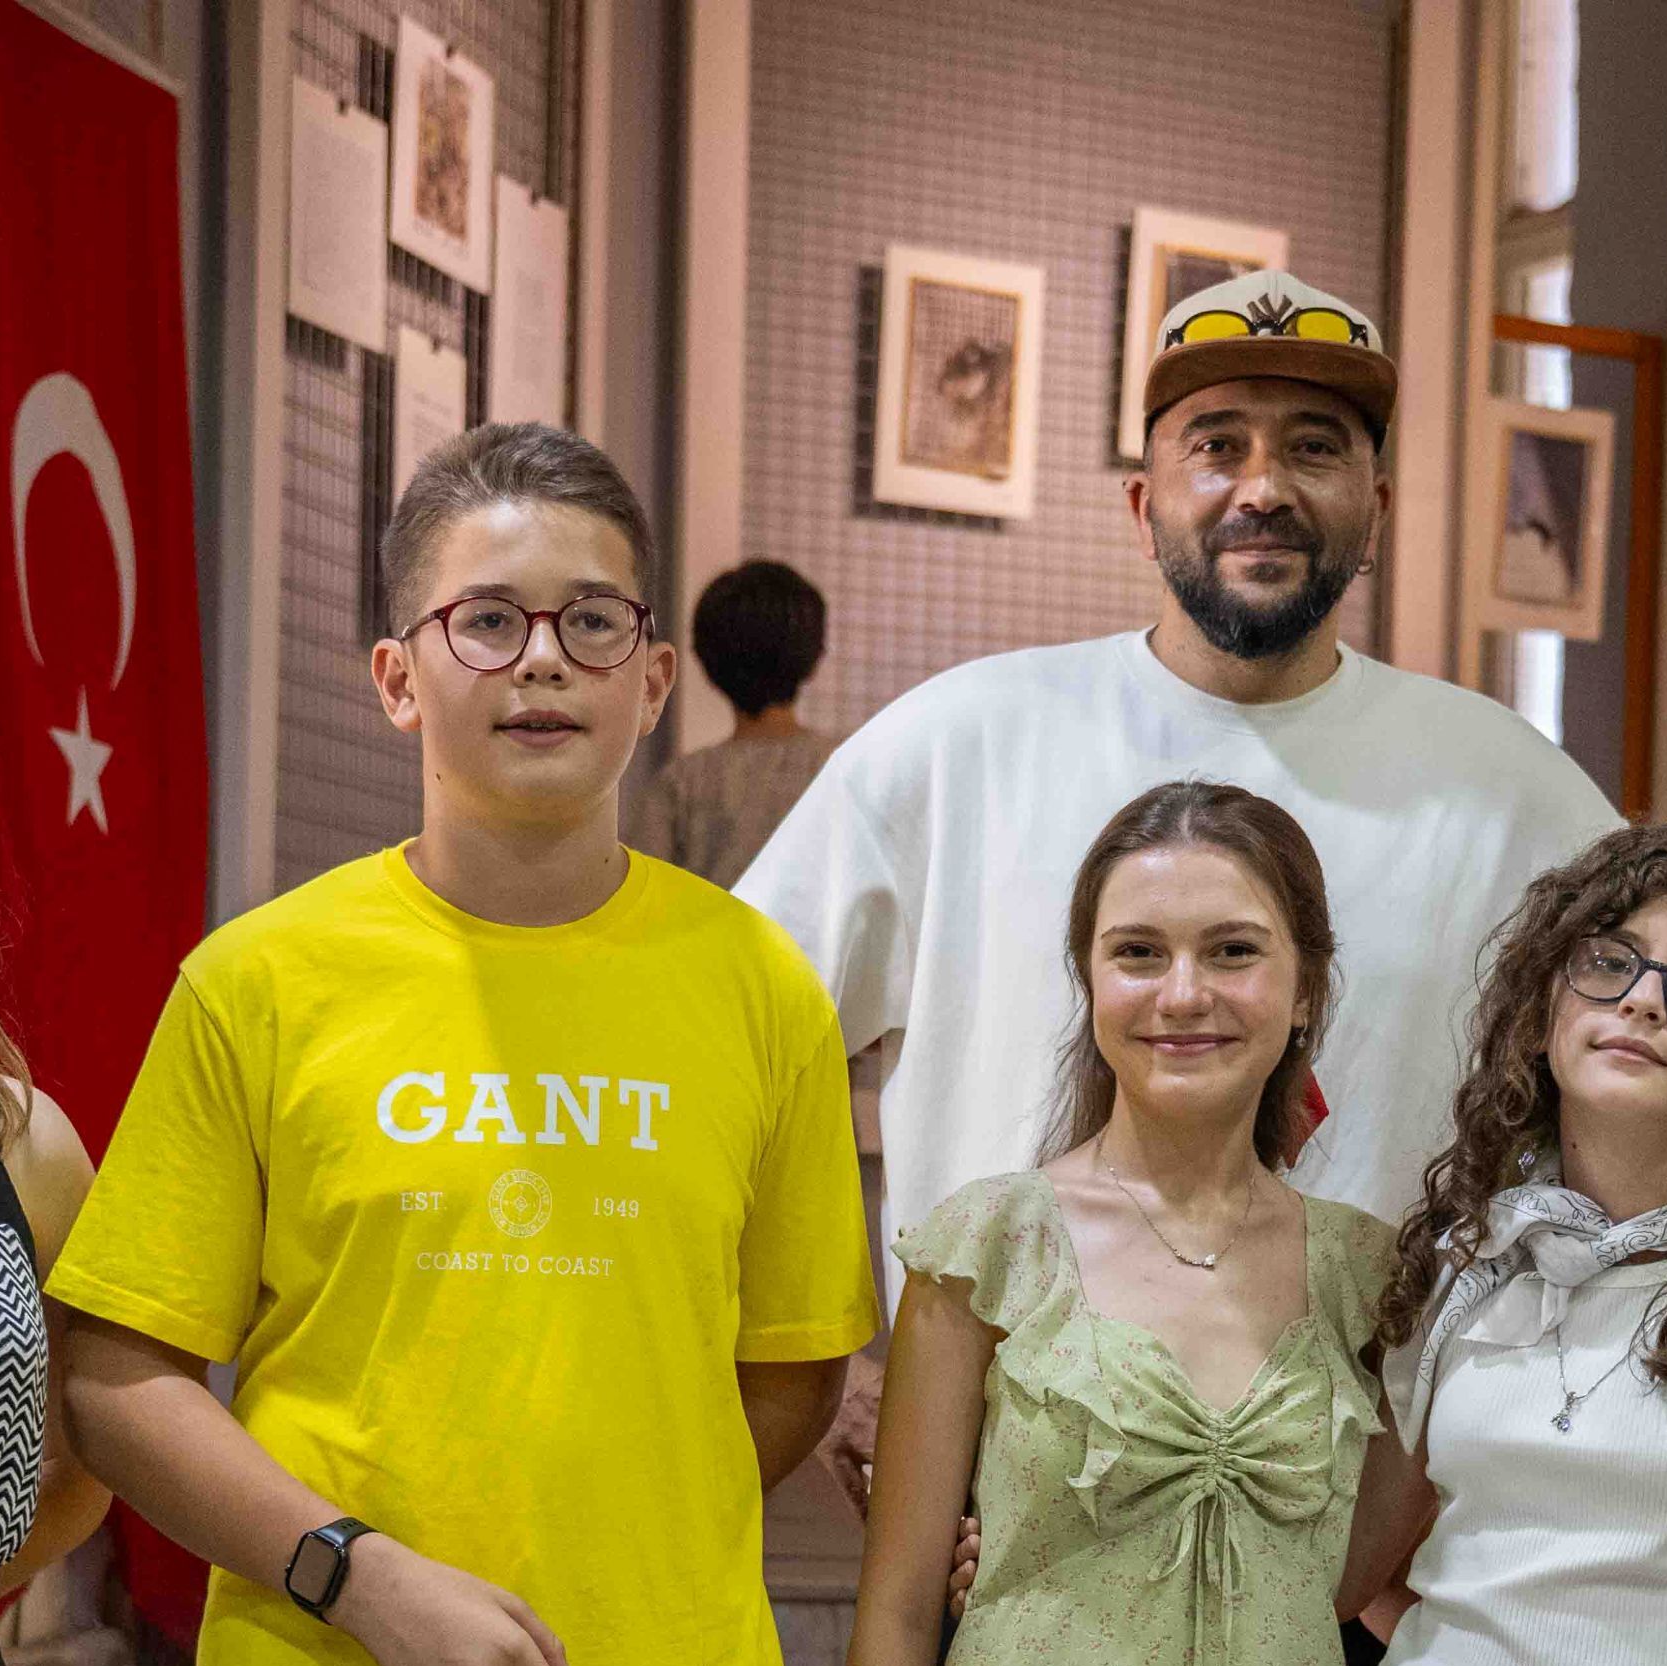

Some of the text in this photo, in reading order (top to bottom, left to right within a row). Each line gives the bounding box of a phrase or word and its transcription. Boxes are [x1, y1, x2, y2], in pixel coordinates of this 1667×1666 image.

[375, 1070, 671, 1152] GANT
[592, 1197, 641, 1219] 1949
[416, 1252, 614, 1277] COAST TO COAST
